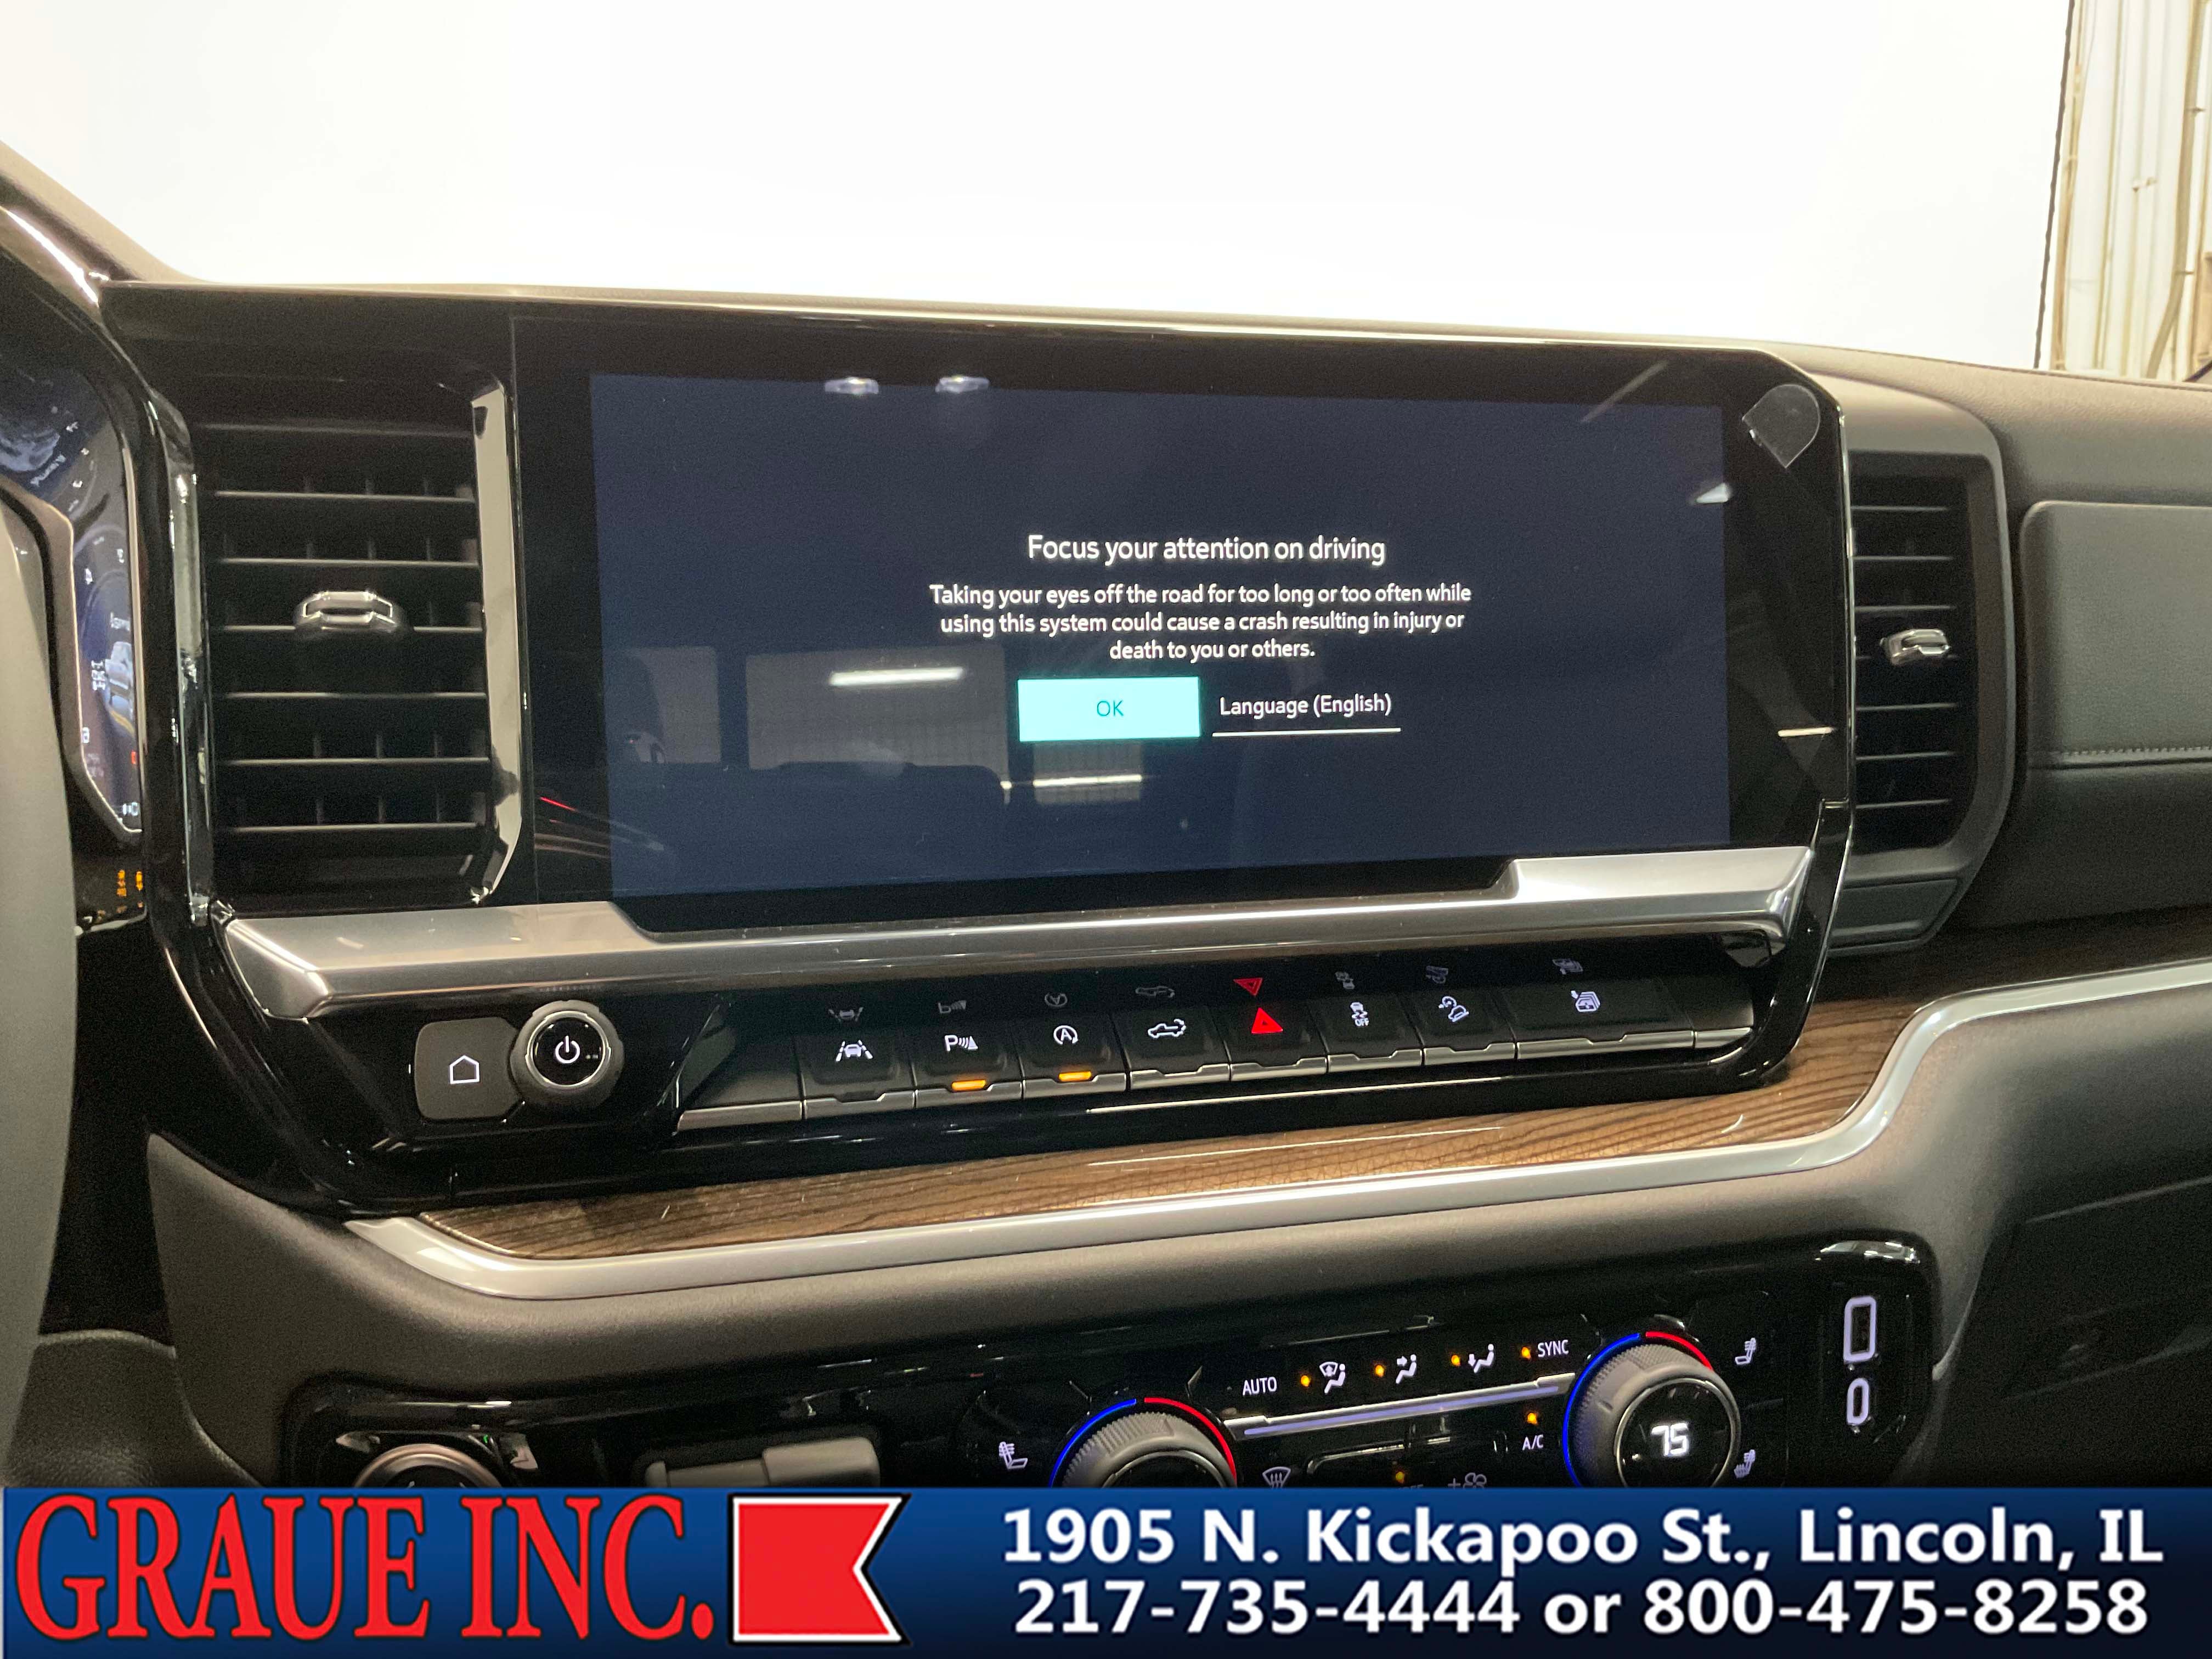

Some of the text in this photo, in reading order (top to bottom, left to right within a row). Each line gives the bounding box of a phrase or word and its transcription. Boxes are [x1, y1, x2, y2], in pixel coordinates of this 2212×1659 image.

[1028, 534, 1386, 567] Focus your attention on driving
[929, 583, 1471, 609] Taking your eyes off the road for too long or too often while
[940, 611, 1465, 637] using this system could cause a crash resulting in injury or
[1110, 638, 1315, 663] death to you or others.
[1097, 700, 1124, 716] OK
[1220, 693, 1392, 720] Language (English)
[1537, 1339, 1569, 1358] SYNC
[1242, 1376, 1277, 1396] AUTO
[1521, 1434, 1544, 1451] A/C
[1650, 1421, 1690, 1457] 75
